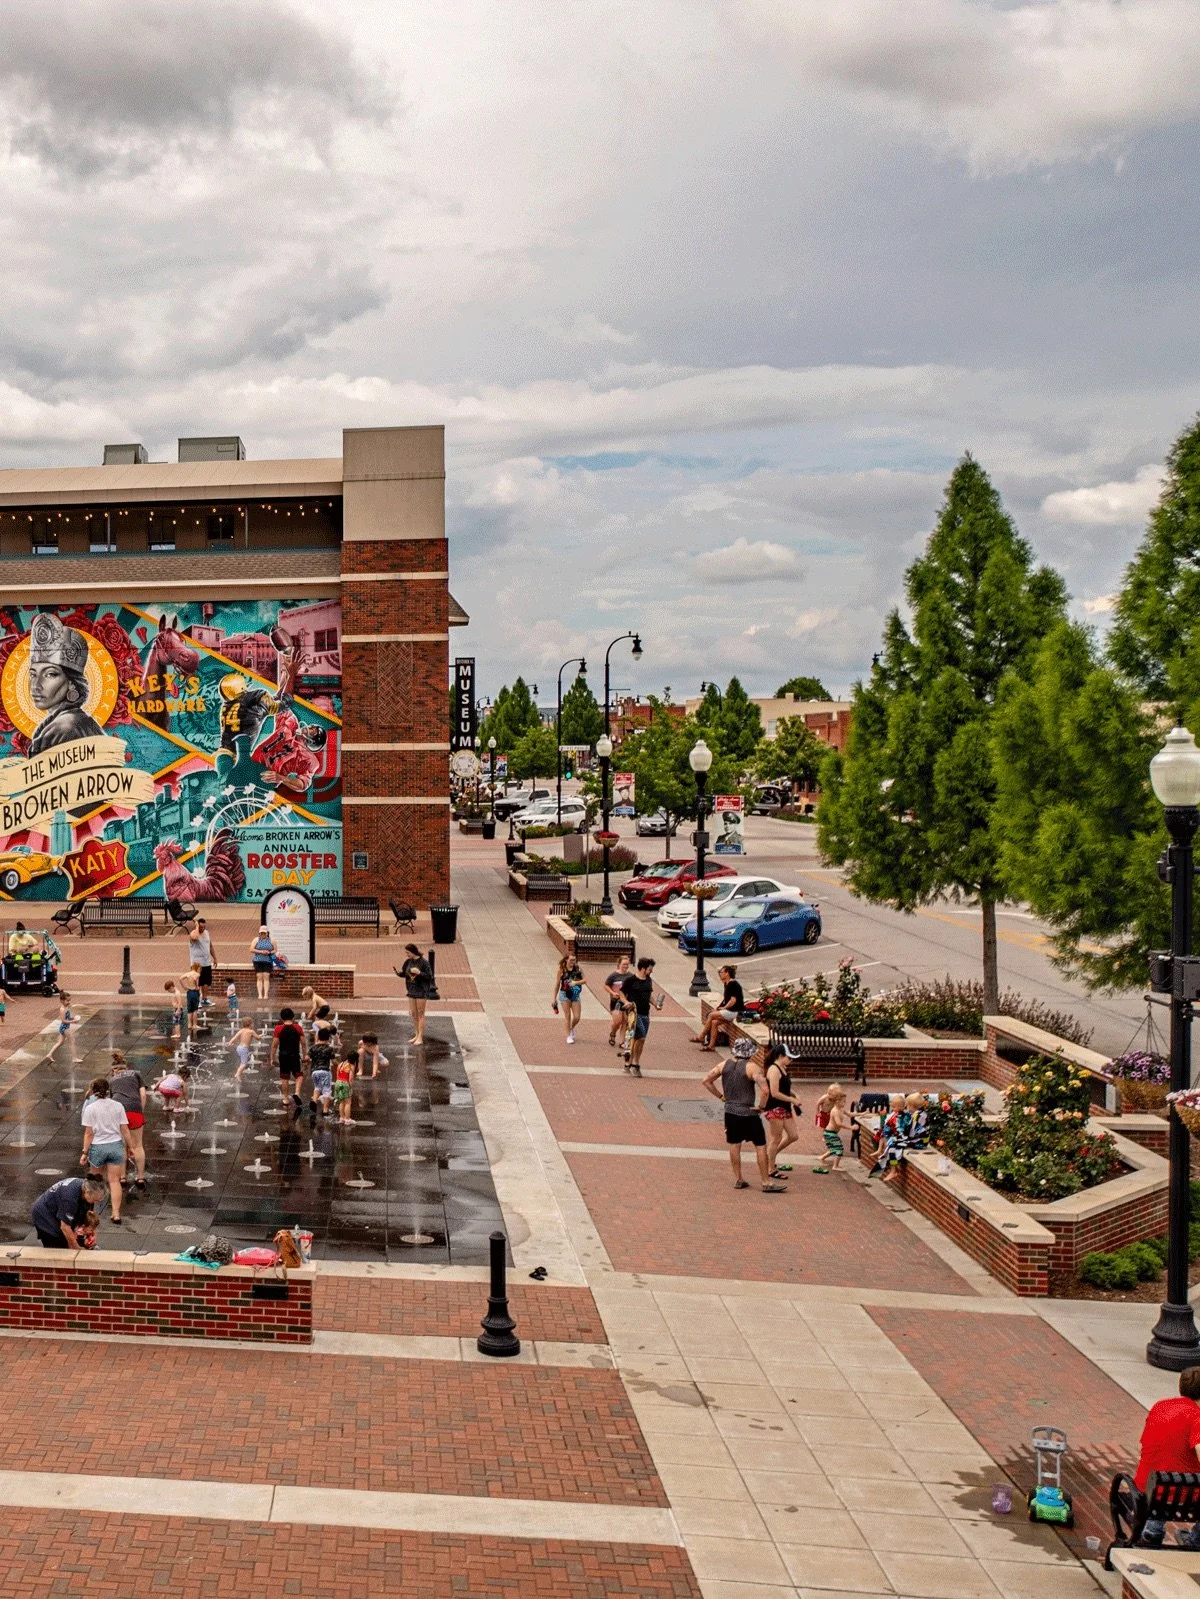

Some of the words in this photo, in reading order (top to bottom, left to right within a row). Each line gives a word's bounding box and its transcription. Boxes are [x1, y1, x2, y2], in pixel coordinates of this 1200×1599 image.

[127, 673, 200, 699] KEY'S
[127, 696, 207, 714] HARDWARE
[459, 665, 472, 747] MUSEUM
[22, 760, 45, 785] THE
[49, 744, 96, 772] MUSEUM
[3, 782, 69, 831] BROKEN
[77, 773, 134, 801] ARROW
[265, 831, 300, 841] BROKEN
[304, 830, 340, 840] ARROW'S
[264, 844, 313, 853] ANNUAL
[69, 847, 119, 878] KATY
[247, 853, 338, 870] ROOSTER
[272, 870, 317, 886] DAY
[322, 890, 340, 898] 1931
